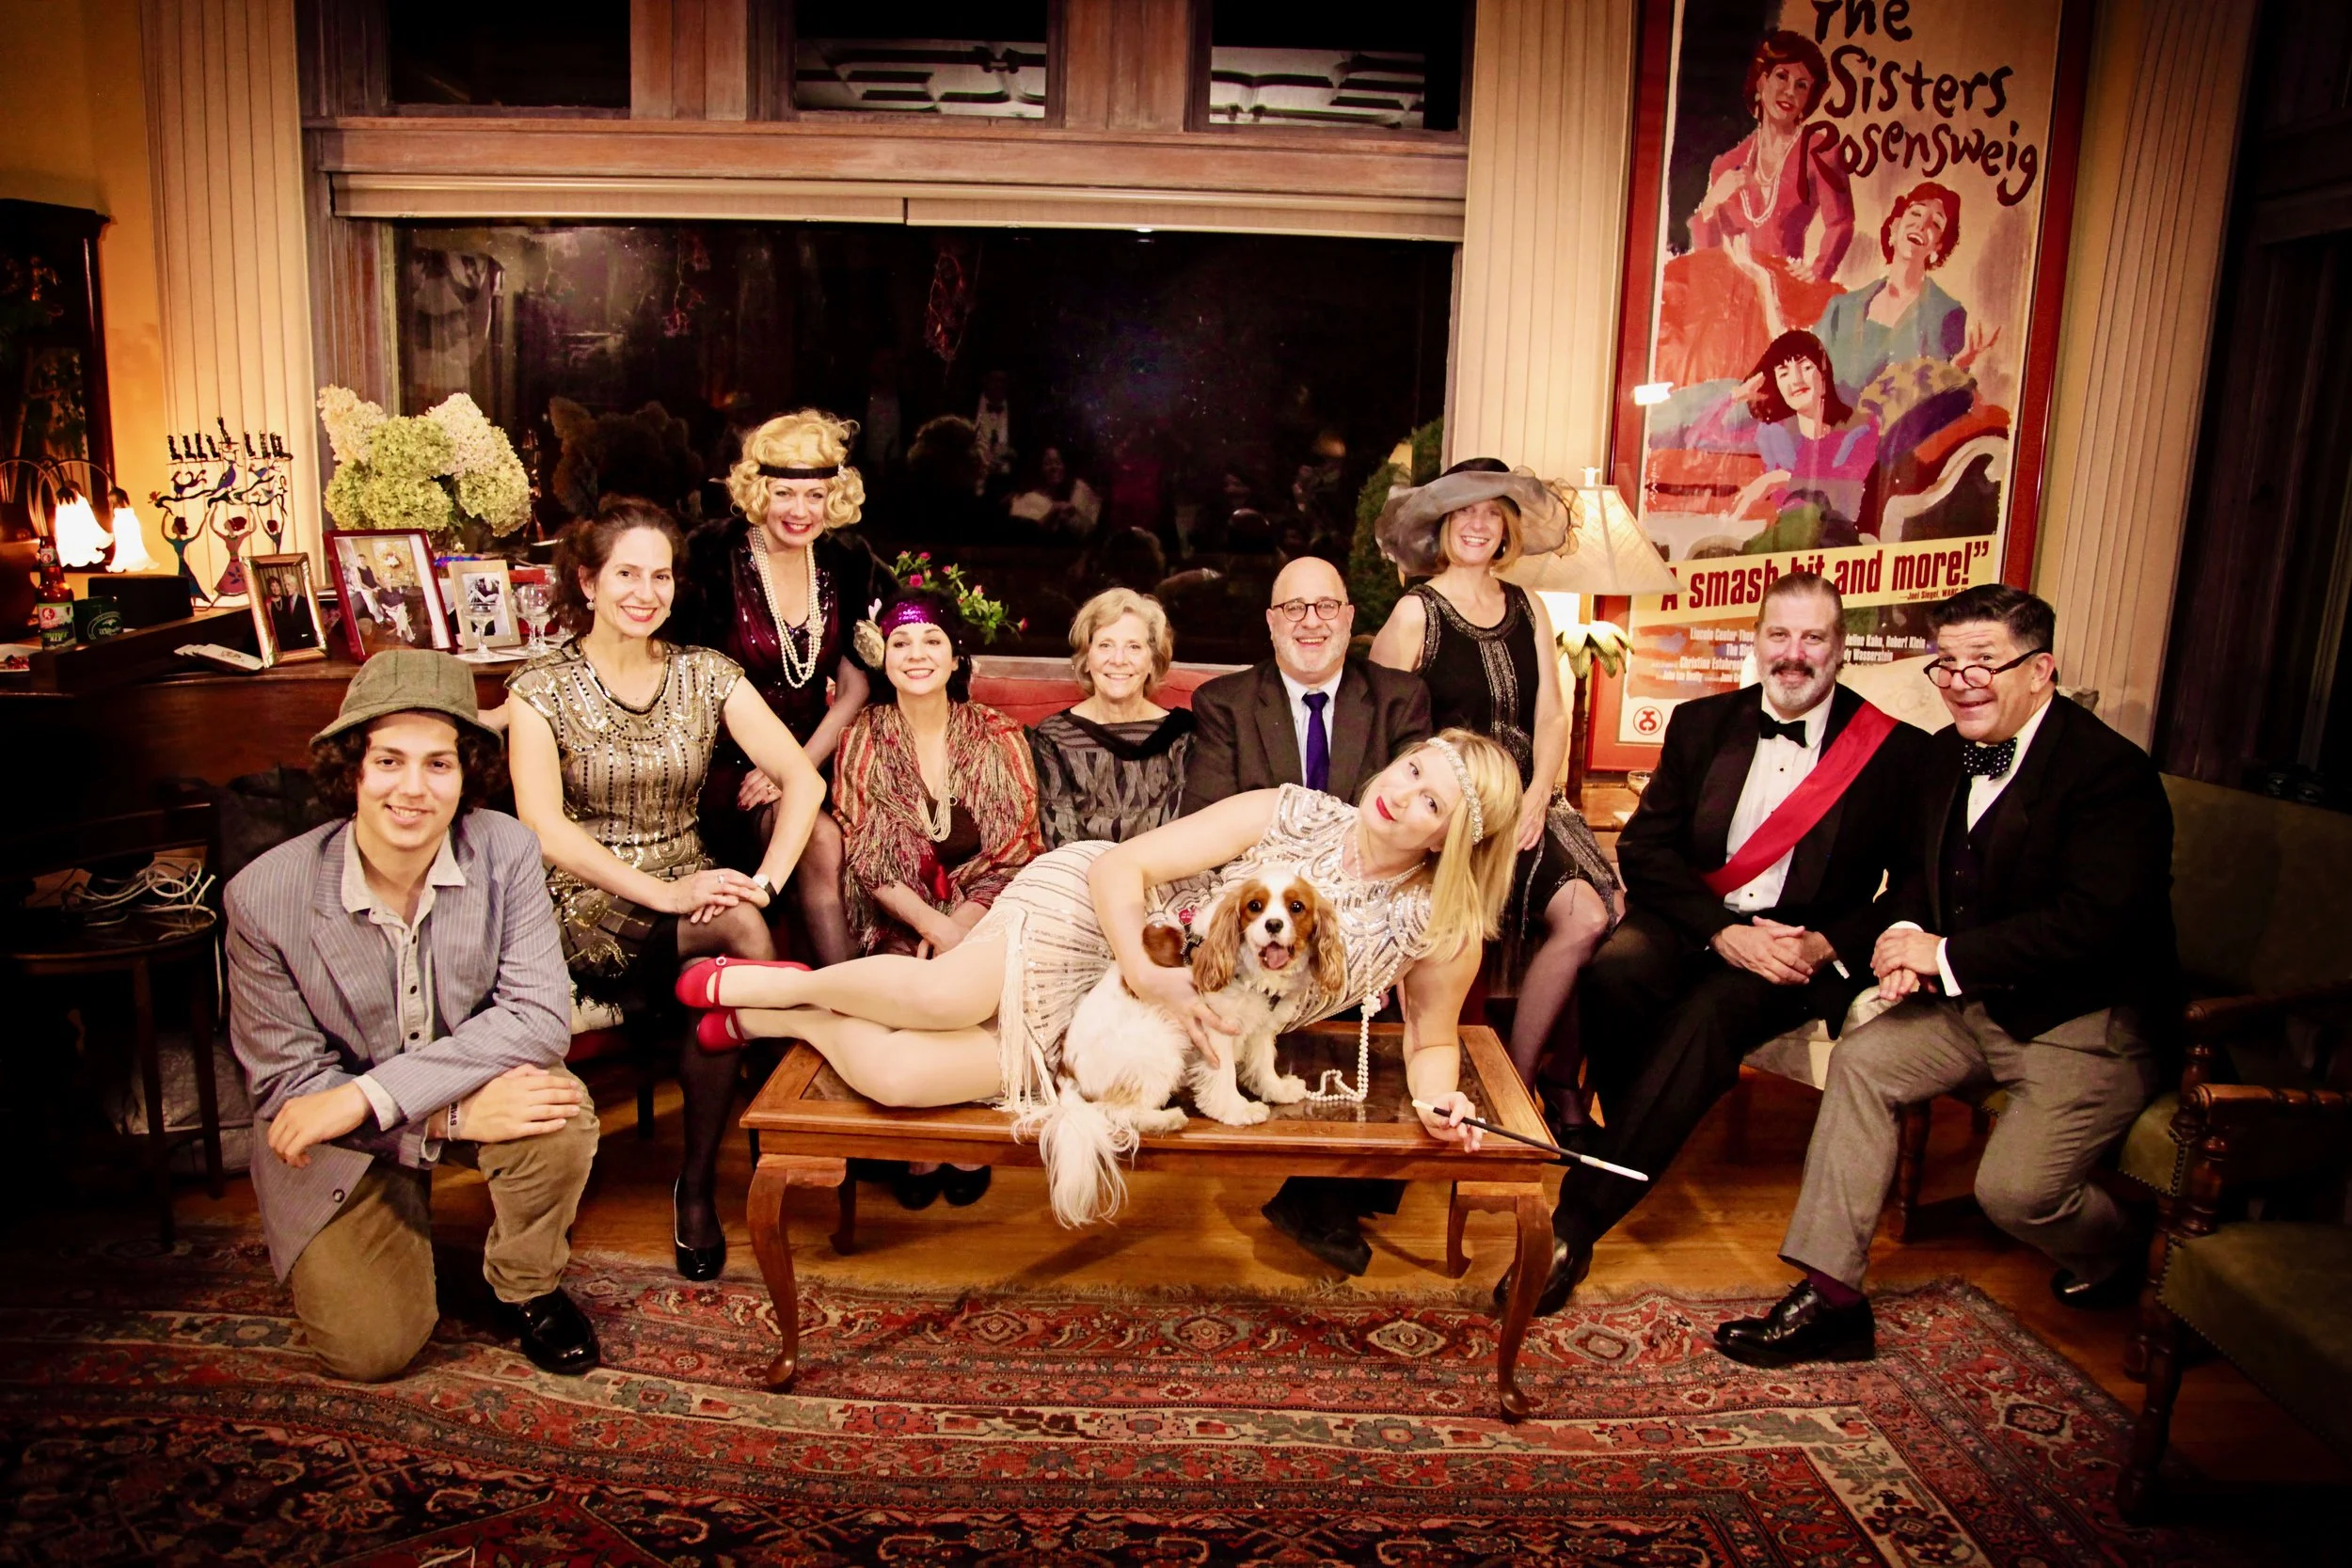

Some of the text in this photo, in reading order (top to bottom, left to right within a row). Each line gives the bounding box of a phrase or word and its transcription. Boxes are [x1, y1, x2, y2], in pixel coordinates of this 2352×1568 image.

[1811, 0, 1913, 44] The
[1824, 44, 2013, 119] Sisters
[1797, 120, 2037, 206] Rosensweig
[1689, 559, 1779, 609] smash
[1835, 549, 1883, 595] and
[1690, 626, 1714, 640] Lincoln
[1740, 629, 1756, 642] Thea
[1886, 635, 1908, 649] Robert
[1909, 636, 1926, 649] Klein
[1725, 642, 1739, 657] The
[1853, 648, 1894, 663] Wasserstein
